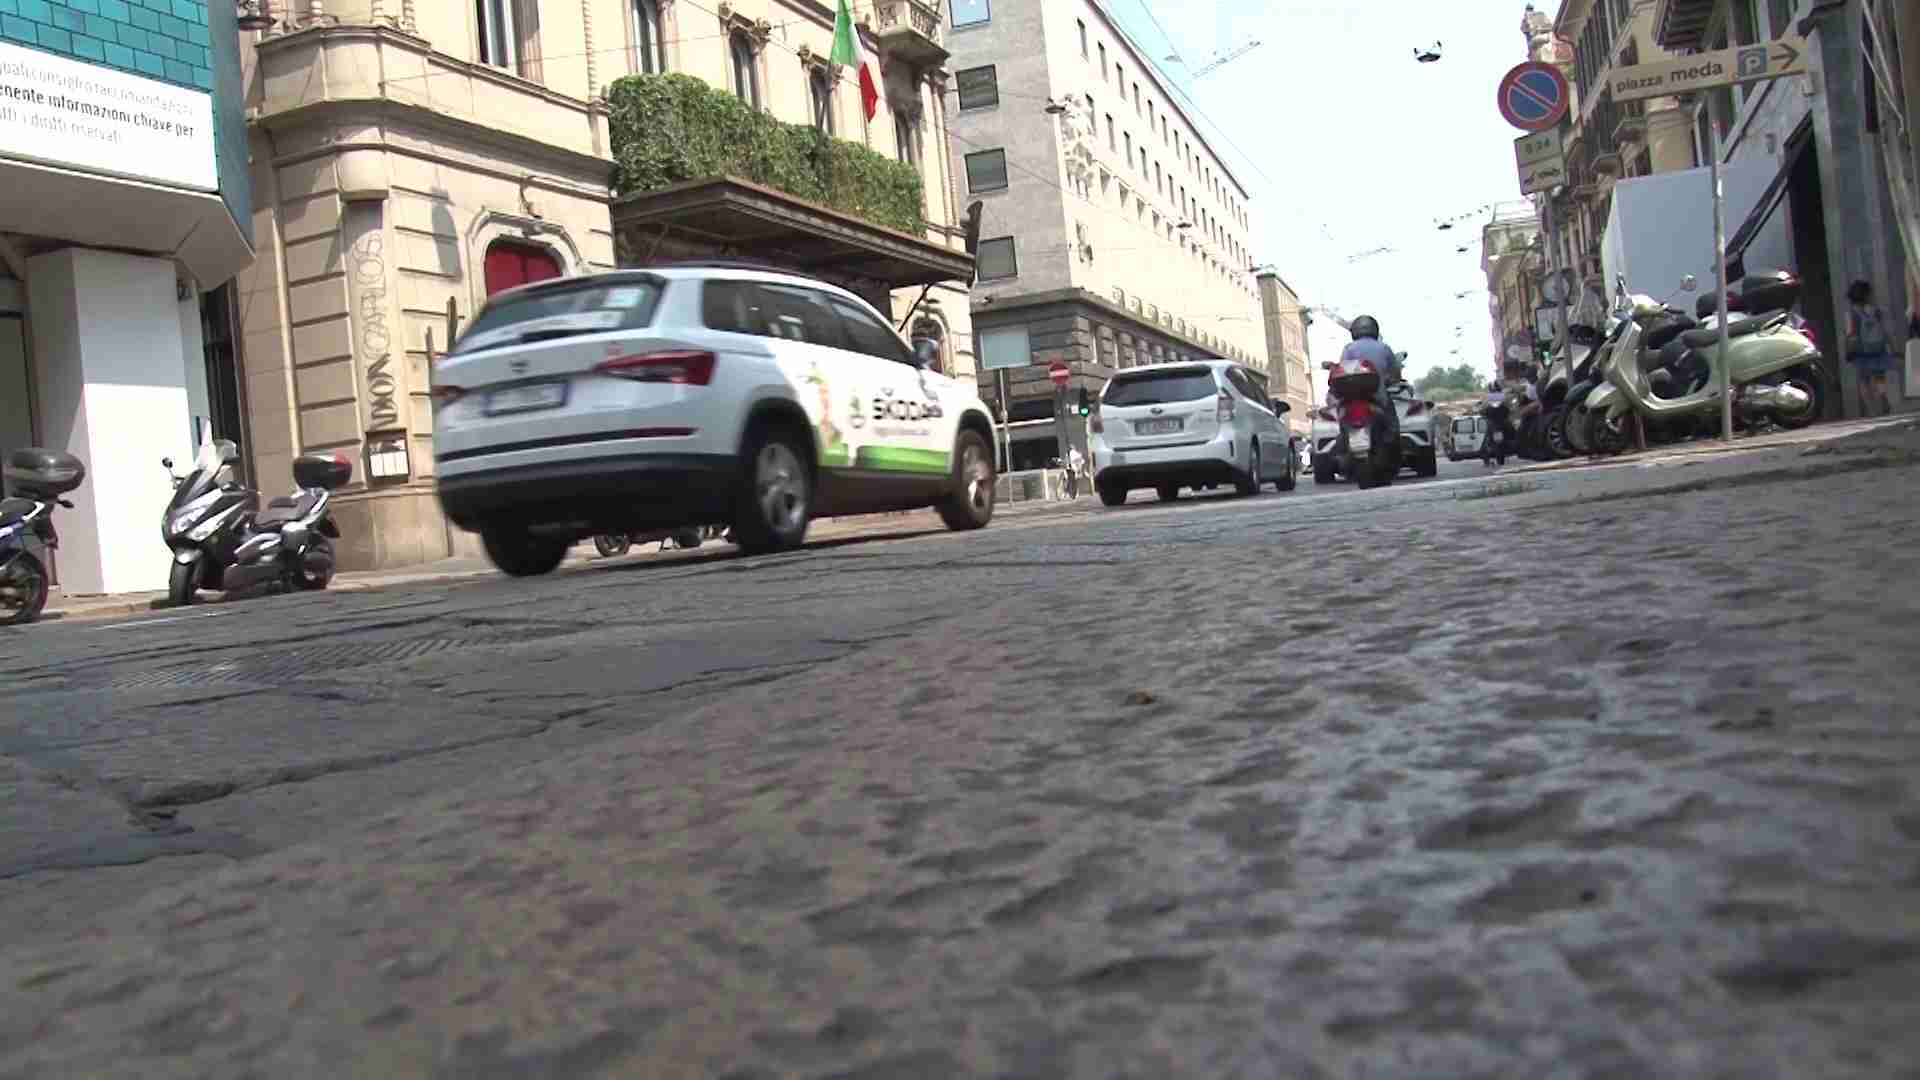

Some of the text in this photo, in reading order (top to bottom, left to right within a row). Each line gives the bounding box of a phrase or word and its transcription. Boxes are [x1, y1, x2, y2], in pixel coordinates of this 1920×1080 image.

[1616, 73, 1663, 94] piazza
[1670, 60, 1724, 83] meda
[49, 93, 130, 123] informazioni
[133, 112, 172, 132] chiave
[176, 123, 194, 137] per
